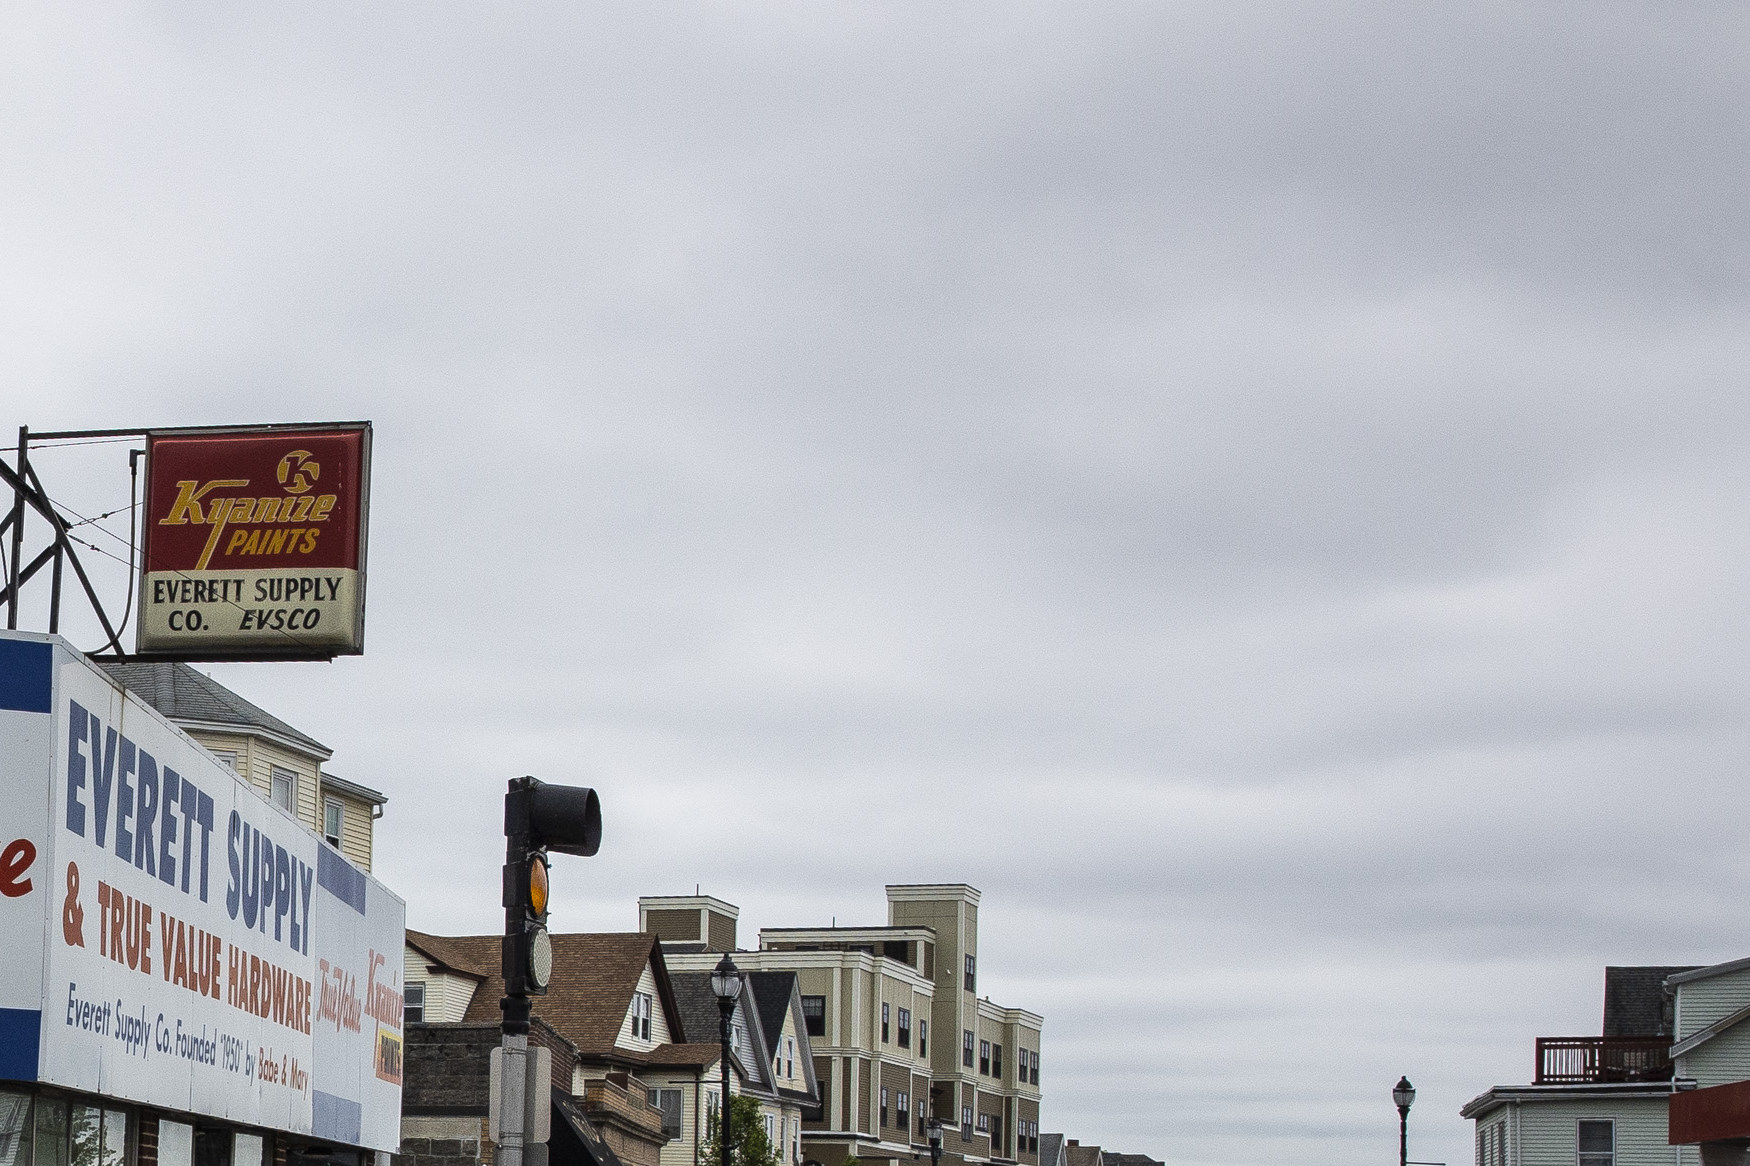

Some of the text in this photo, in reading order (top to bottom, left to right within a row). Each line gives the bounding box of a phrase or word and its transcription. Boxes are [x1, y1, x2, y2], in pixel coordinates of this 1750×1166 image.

[158, 479, 337, 570] Kyanize
[225, 528, 320, 556] PAINTS
[153, 577, 344, 603] EVERETT SUPPLY
[168, 608, 321, 631] CO. EVSCO
[66, 698, 313, 957] EVERETT SUPPLY
[63, 861, 312, 1036] & TRUE VALUE HARDWARE
[66, 982, 111, 1036] Everett
[115, 999, 151, 1059] Supply
[155, 1013, 172, 1055] Co.
[176, 1019, 218, 1066] Founded
[246, 1040, 256, 1086] by
[258, 1047, 279, 1084] Babe
[281, 1054, 288, 1086] &
[290, 1057, 309, 1100] Mary
